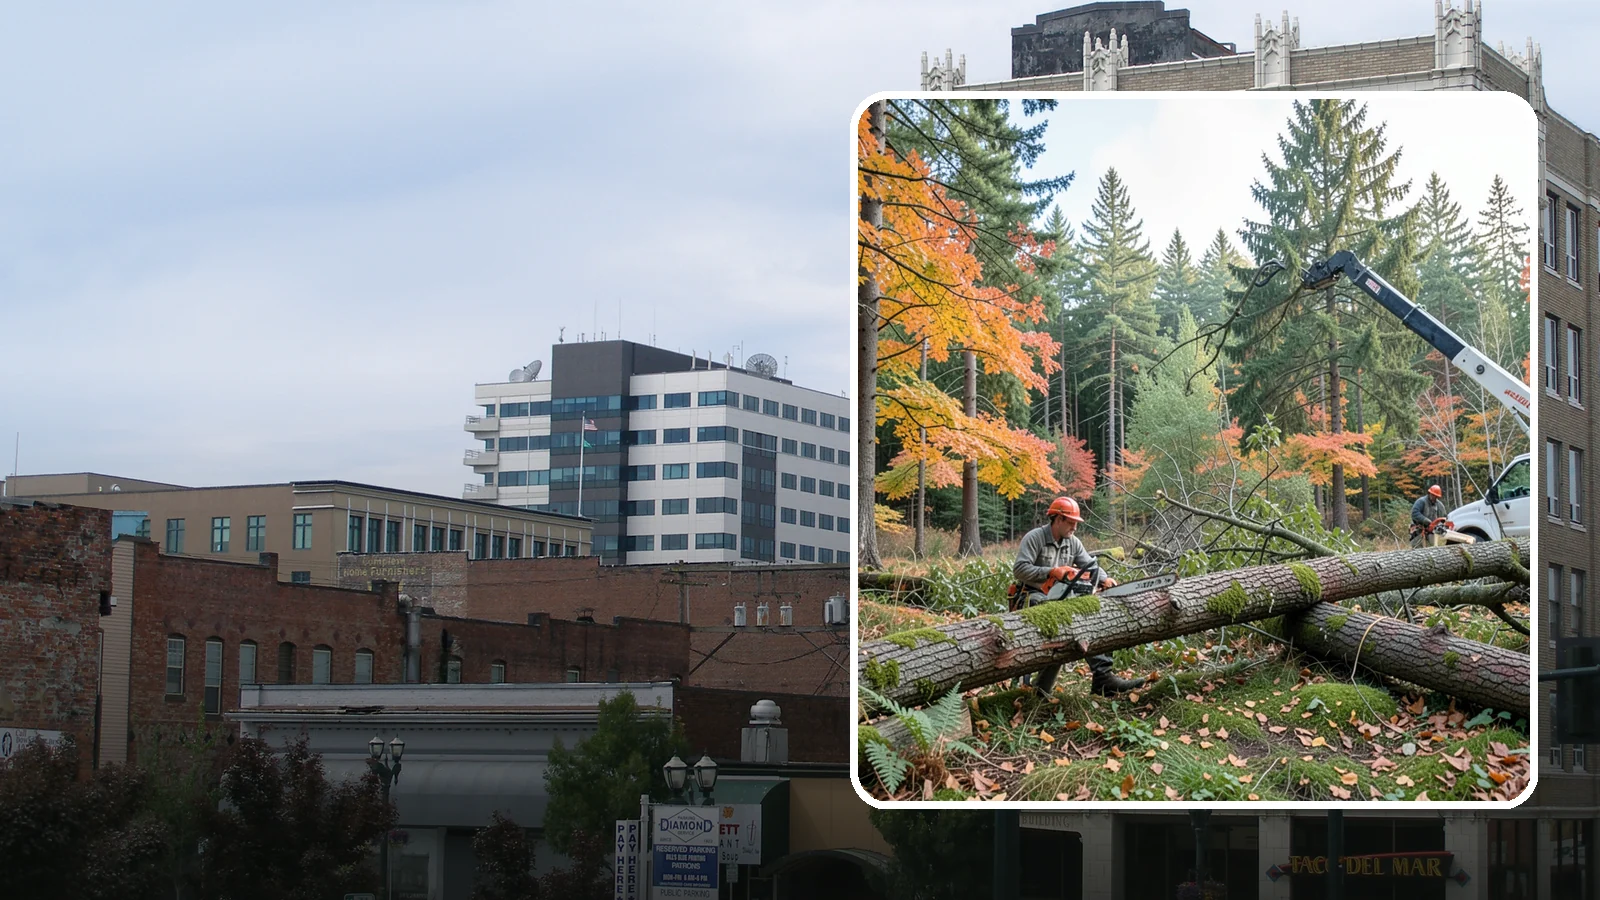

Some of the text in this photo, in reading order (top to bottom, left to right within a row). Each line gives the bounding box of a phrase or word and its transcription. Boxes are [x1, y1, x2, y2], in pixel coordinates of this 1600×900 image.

[343, 566, 427, 577] Home Furnishers
[660, 818, 713, 833] DIAMOND
[1022, 815, 1070, 828] BUILDING
[656, 845, 716, 854] RESERVED PARKING
[671, 862, 701, 870] PATRONS
[1345, 856, 1385, 876] DEL
[1392, 857, 1442, 877] MAR
[660, 889, 710, 898] PUBLIC PARKING
